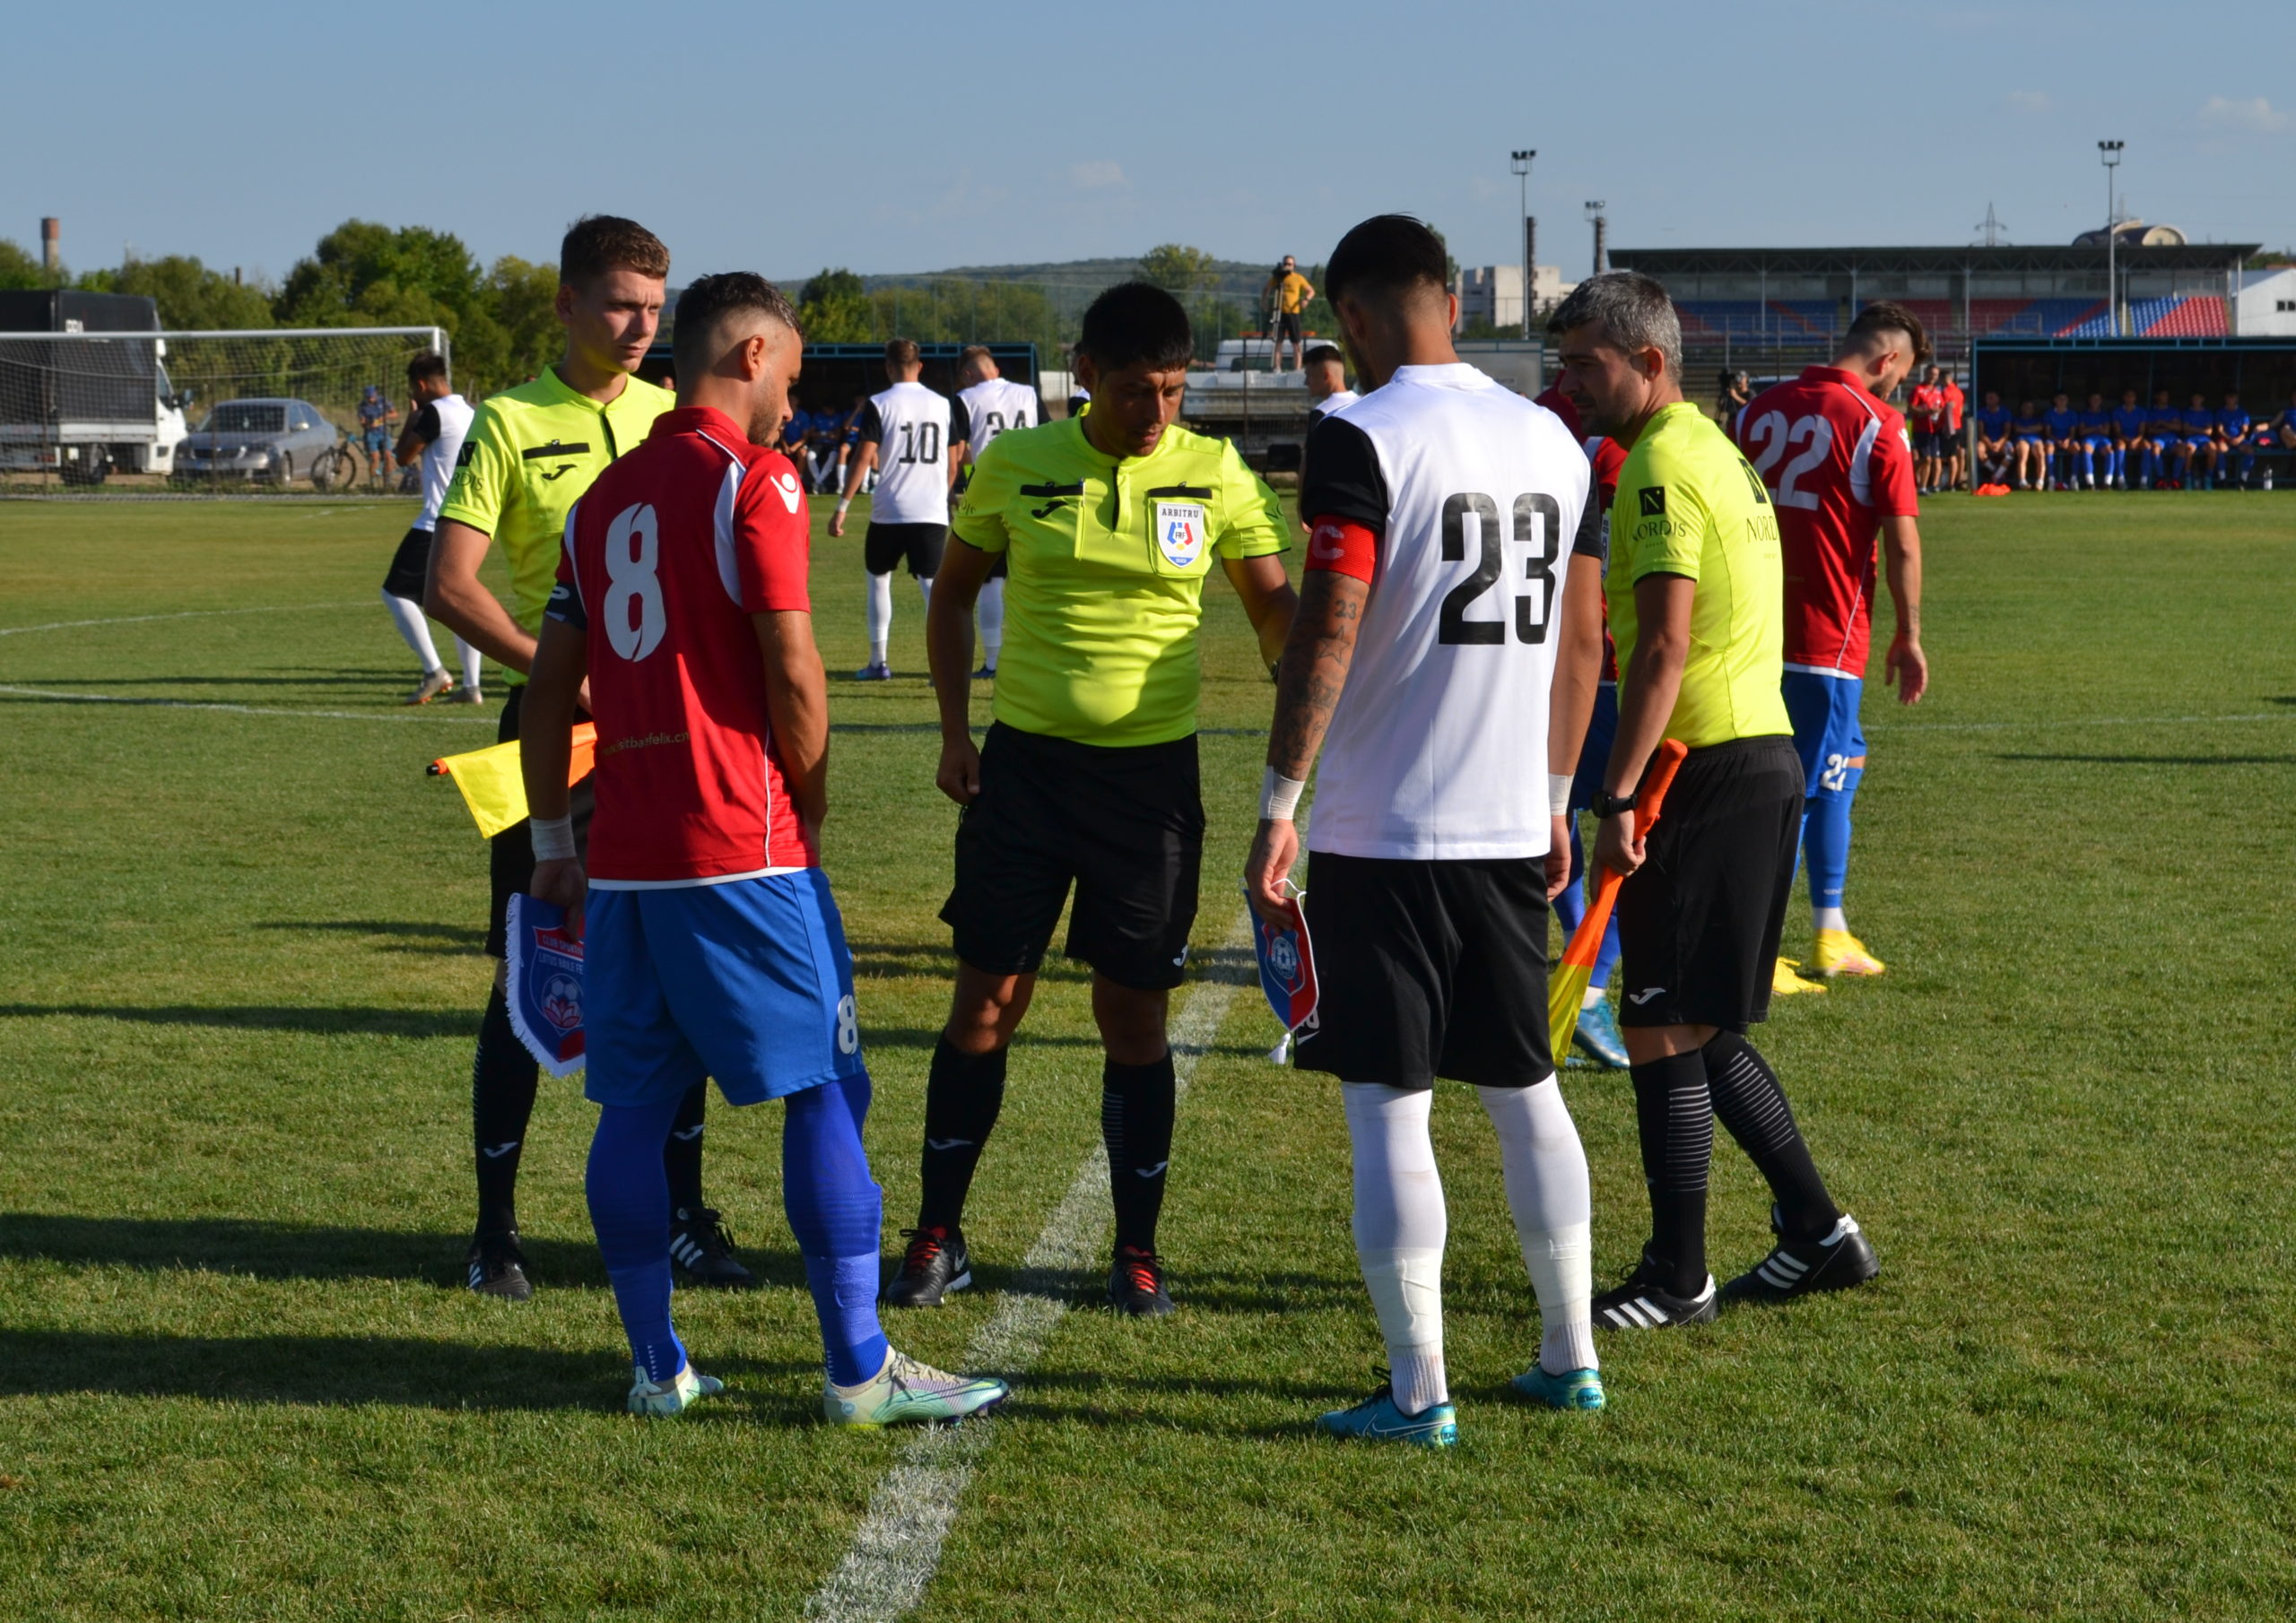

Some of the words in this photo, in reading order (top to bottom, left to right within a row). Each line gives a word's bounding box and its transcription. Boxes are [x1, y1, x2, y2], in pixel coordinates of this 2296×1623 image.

[899, 421, 940, 464] 10
[1750, 409, 1832, 511] 22
[1161, 508, 1199, 518] ARBITRU
[1311, 525, 1345, 560] C
[604, 501, 667, 663] 8
[1438, 492, 1561, 646] 23
[1335, 598, 1358, 621] 23
[838, 994, 858, 1055] 8
